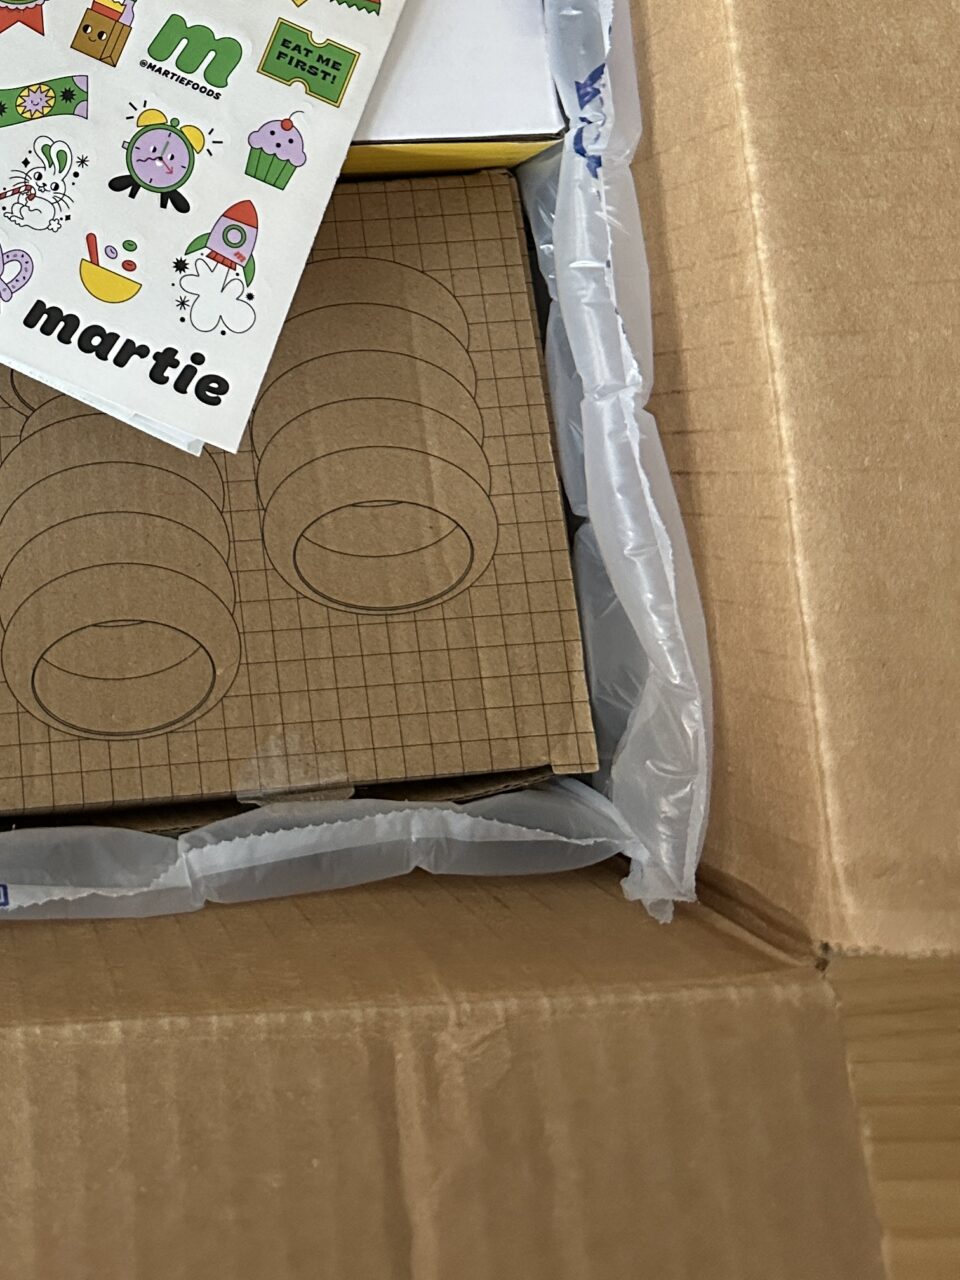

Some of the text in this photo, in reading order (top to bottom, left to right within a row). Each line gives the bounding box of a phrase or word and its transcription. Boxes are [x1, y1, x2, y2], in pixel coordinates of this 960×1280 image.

[276, 51, 338, 84] FIRST!
[280, 38, 343, 72] EAT ME
[139, 59, 222, 100] @MARTIEFOODS
[23, 299, 230, 407] martie
